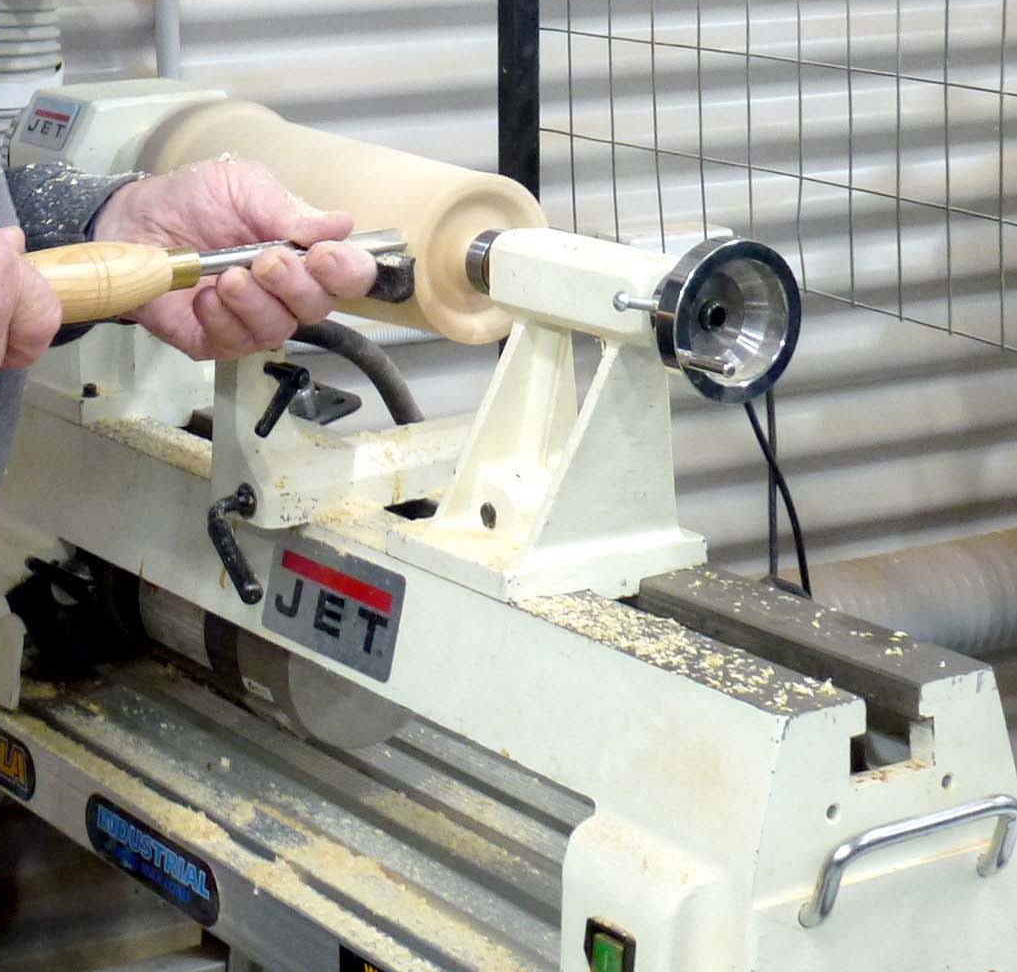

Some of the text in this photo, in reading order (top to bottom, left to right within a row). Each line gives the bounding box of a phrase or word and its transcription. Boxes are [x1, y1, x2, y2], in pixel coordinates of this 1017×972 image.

[28, 119, 66, 138] JET
[275, 579, 388, 655] JET
[97, 804, 210, 900] INDUSTRIAL
